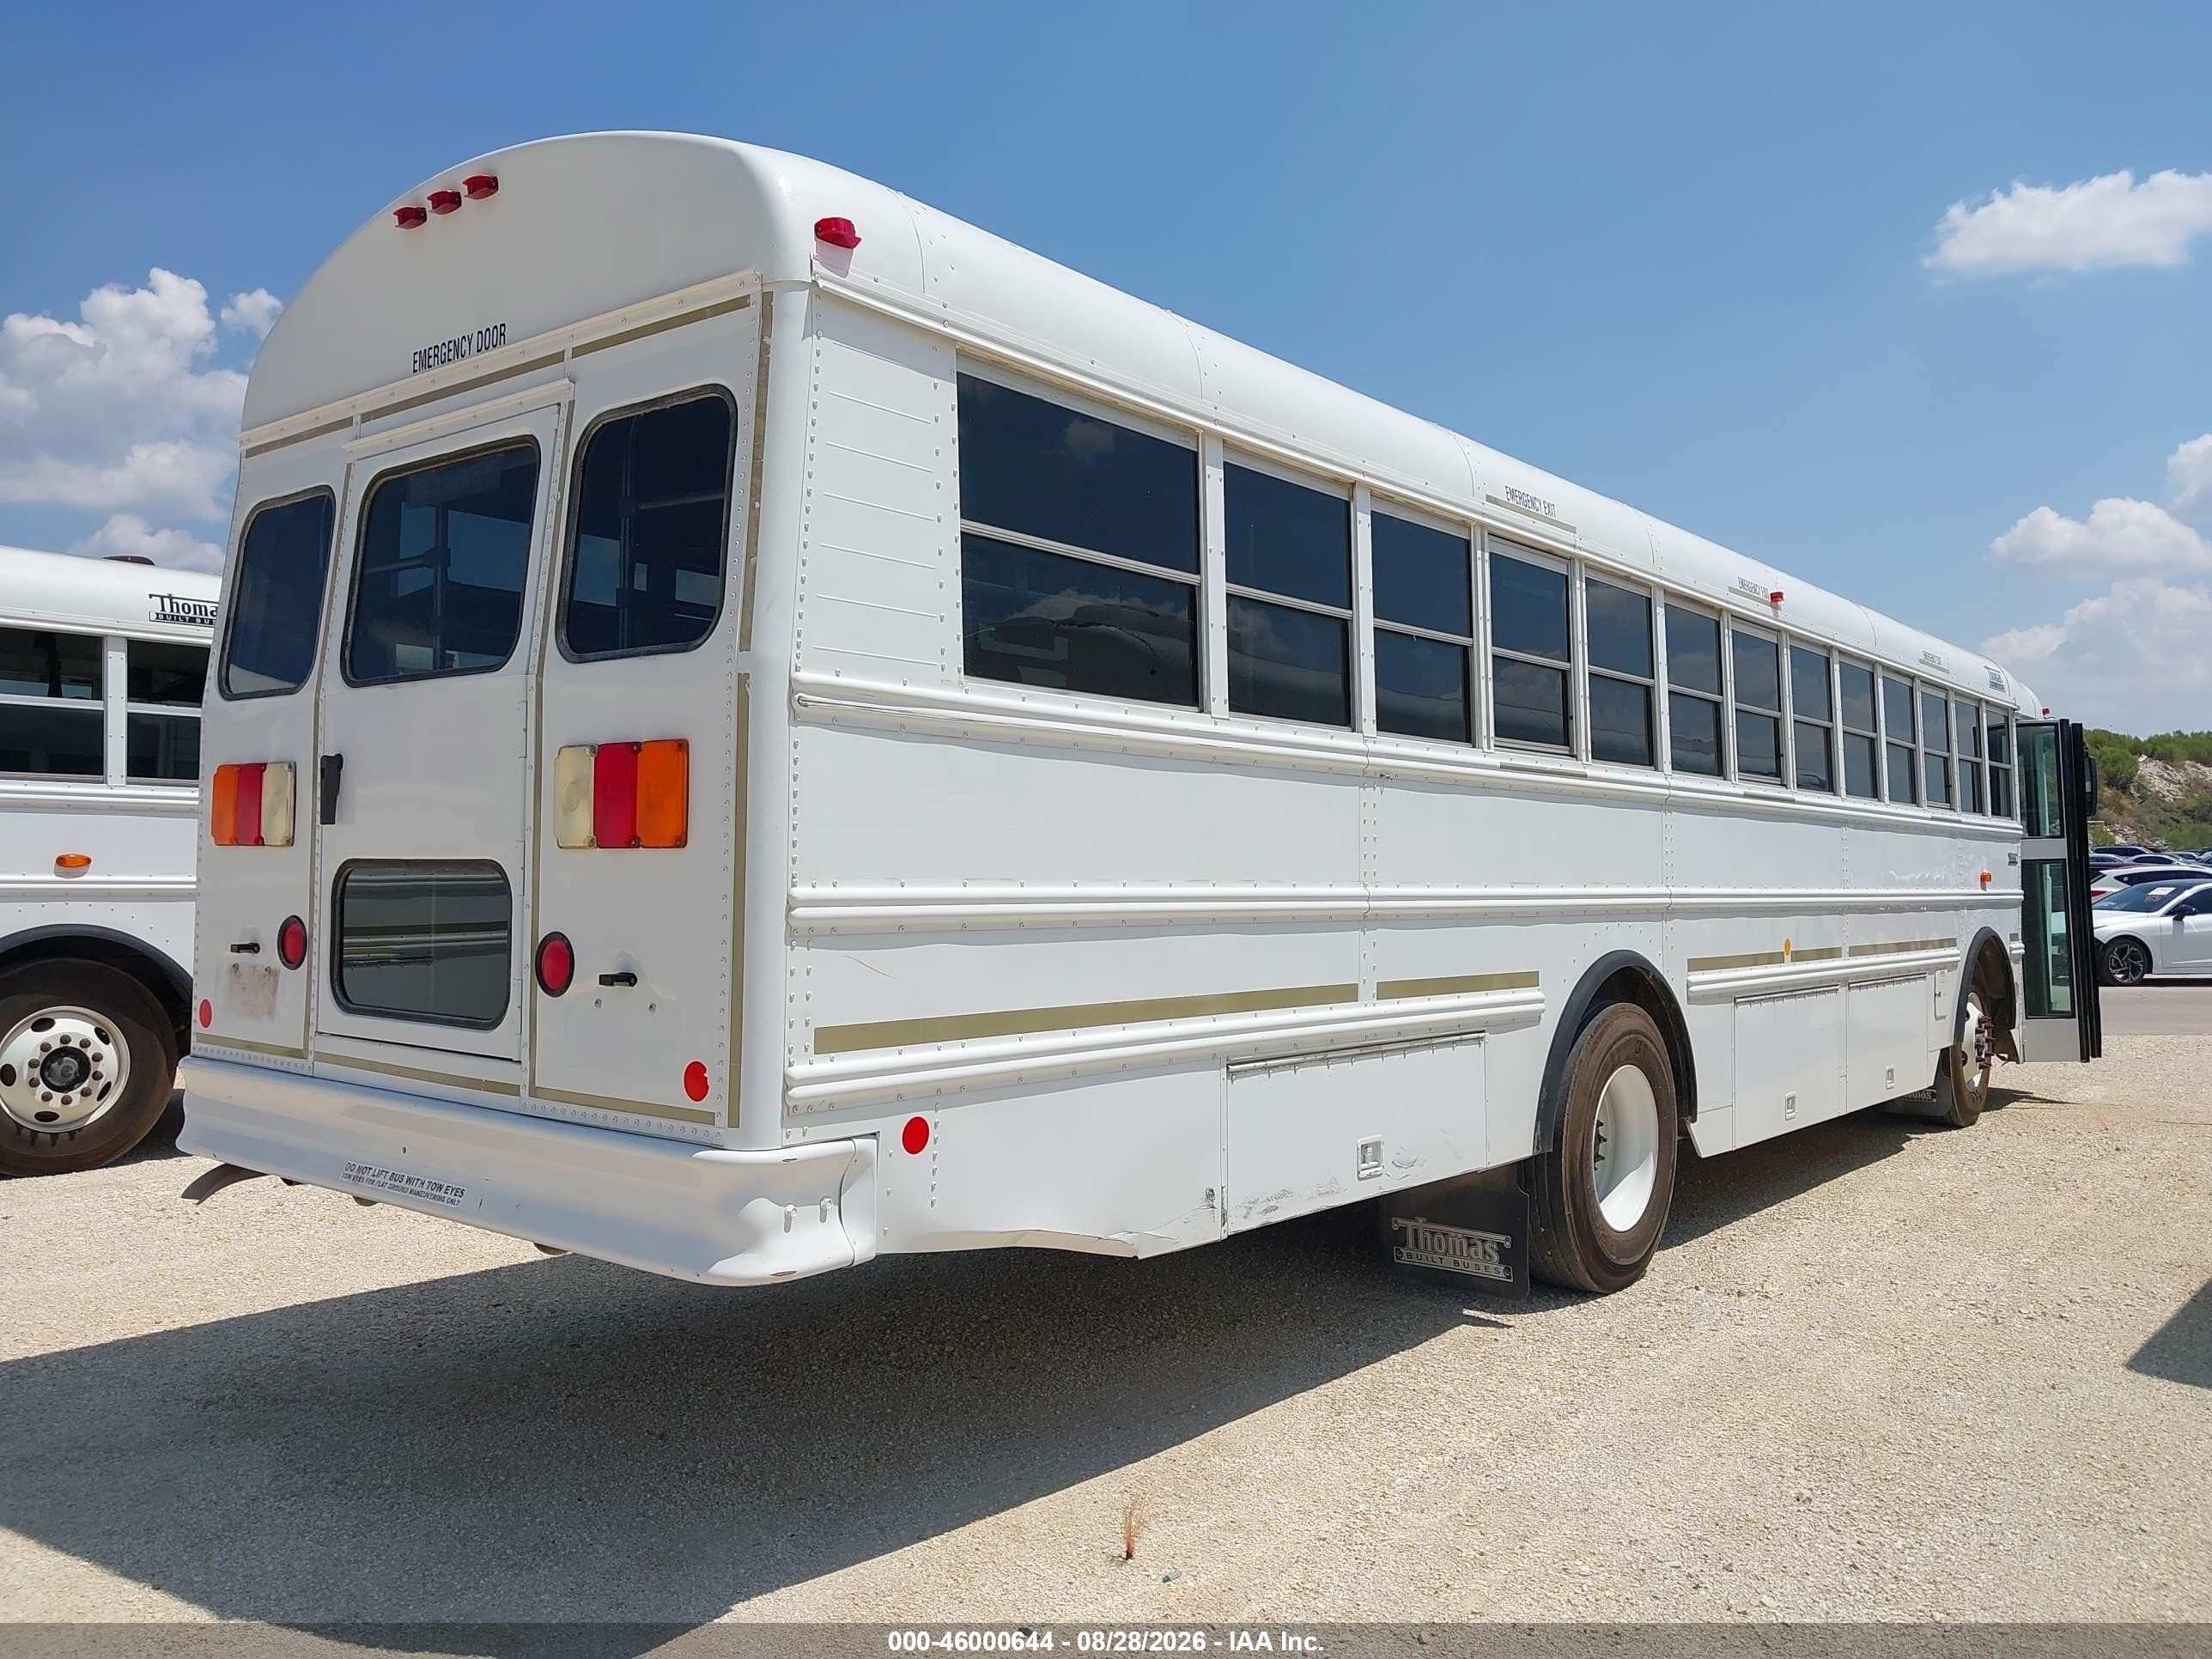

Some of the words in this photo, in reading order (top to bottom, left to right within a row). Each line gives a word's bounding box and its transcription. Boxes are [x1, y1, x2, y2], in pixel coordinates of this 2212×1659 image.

[412, 332, 473, 374] EMERGENCY
[477, 323, 507, 353] DOOR
[1504, 485, 1542, 513] EMERGENCY
[1542, 500, 1557, 518] EXIT
[149, 592, 219, 617] Thoma
[158, 613, 190, 623] BUILT
[344, 1162, 356, 1173] DO
[356, 1164, 373, 1176] NOT
[372, 1168, 390, 1179] LIFT
[388, 1172, 405, 1183] BUS
[405, 1175, 427, 1189] WITH
[425, 1180, 444, 1194] TOW
[443, 1185, 465, 1199] EYES
[352, 1174, 365, 1183] EYES
[446, 1196, 461, 1206] ONLY
[1392, 1217, 1511, 1265] Thomas
[1406, 1252, 1445, 1264] BUILT
[1453, 1259, 1501, 1275] BUSES
